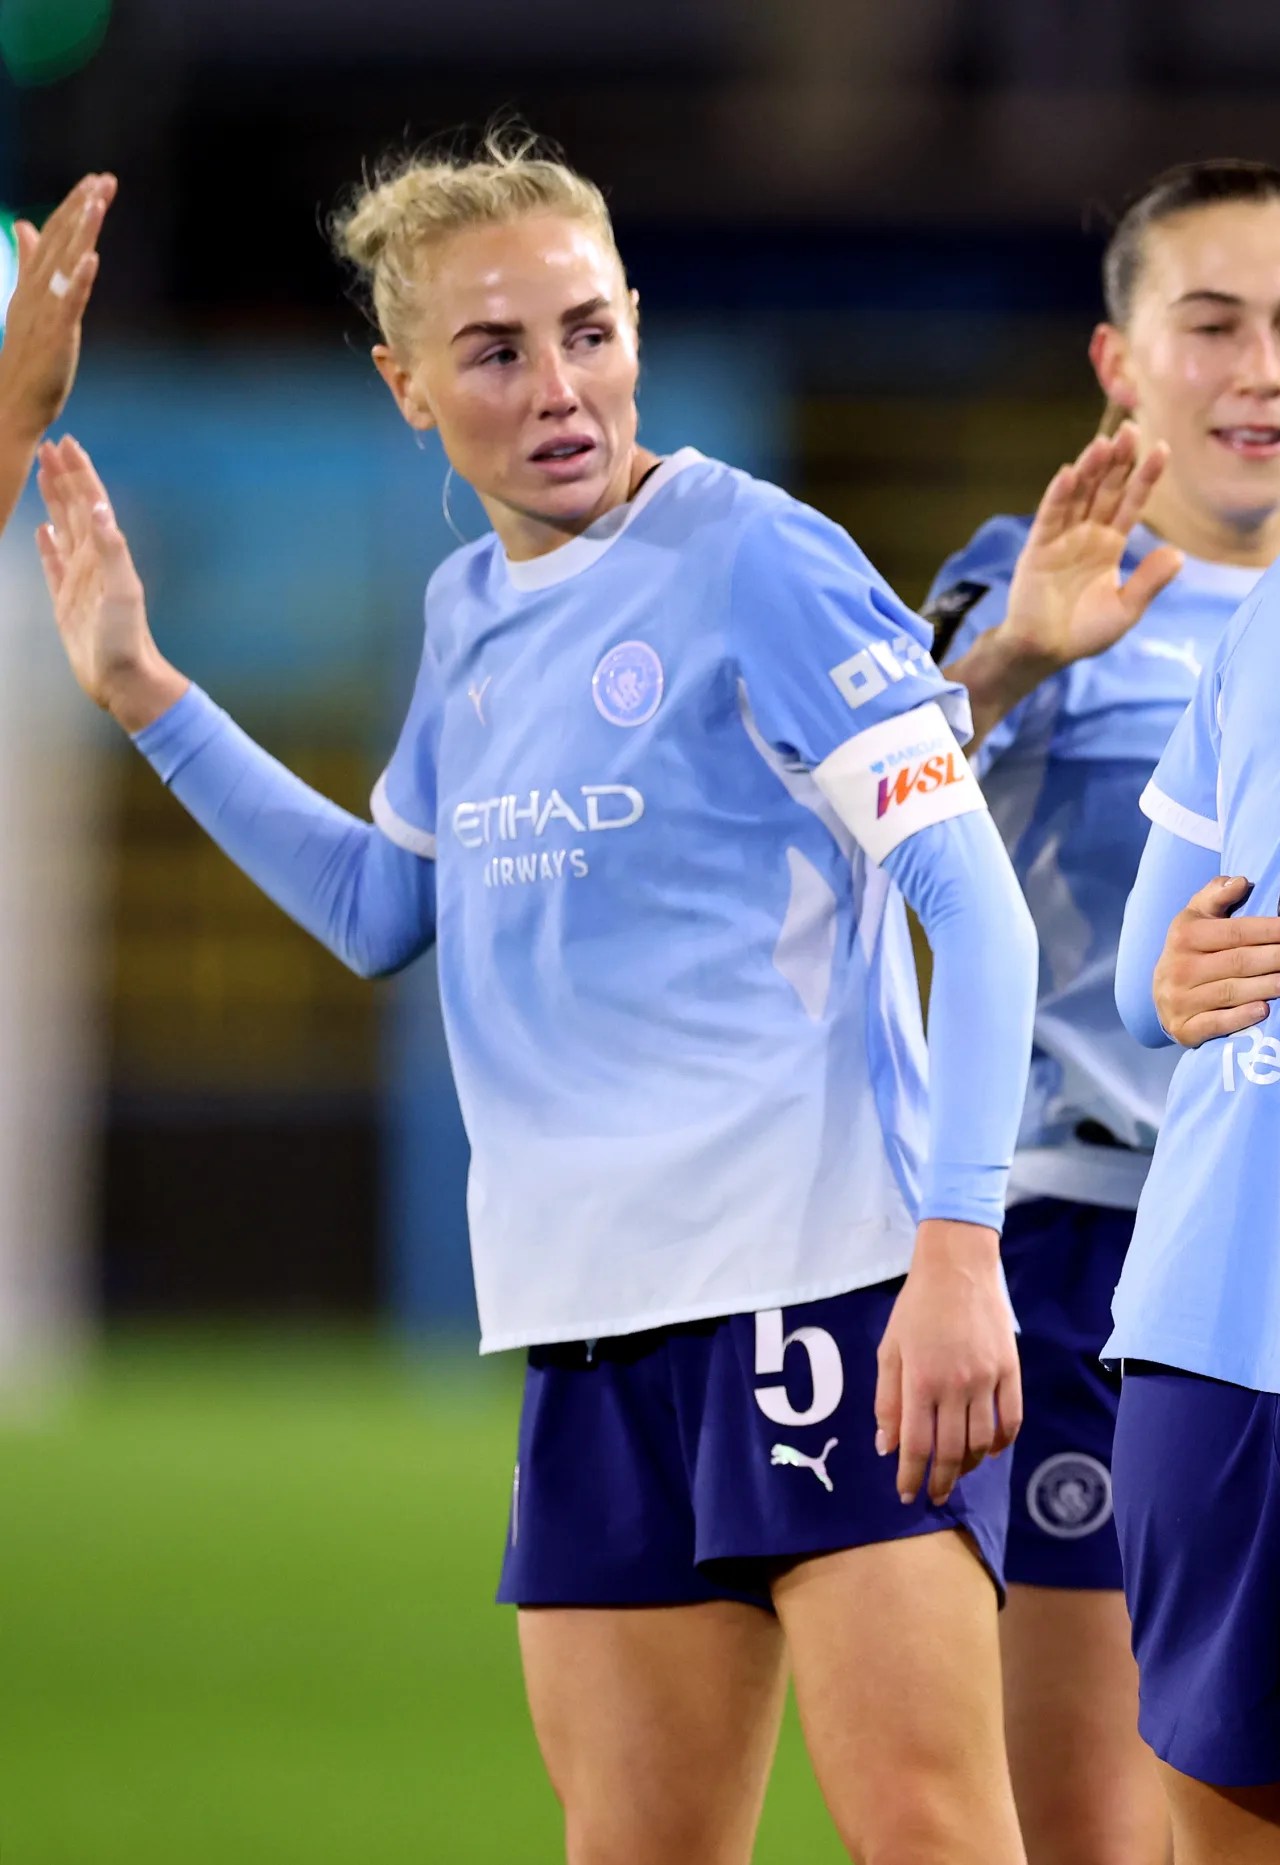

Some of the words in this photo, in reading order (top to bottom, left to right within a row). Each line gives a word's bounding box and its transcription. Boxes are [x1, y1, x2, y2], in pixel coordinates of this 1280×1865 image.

[452, 784, 644, 849] ETIHAD
[877, 752, 964, 819] WSL
[754, 1308, 844, 1427] 5
